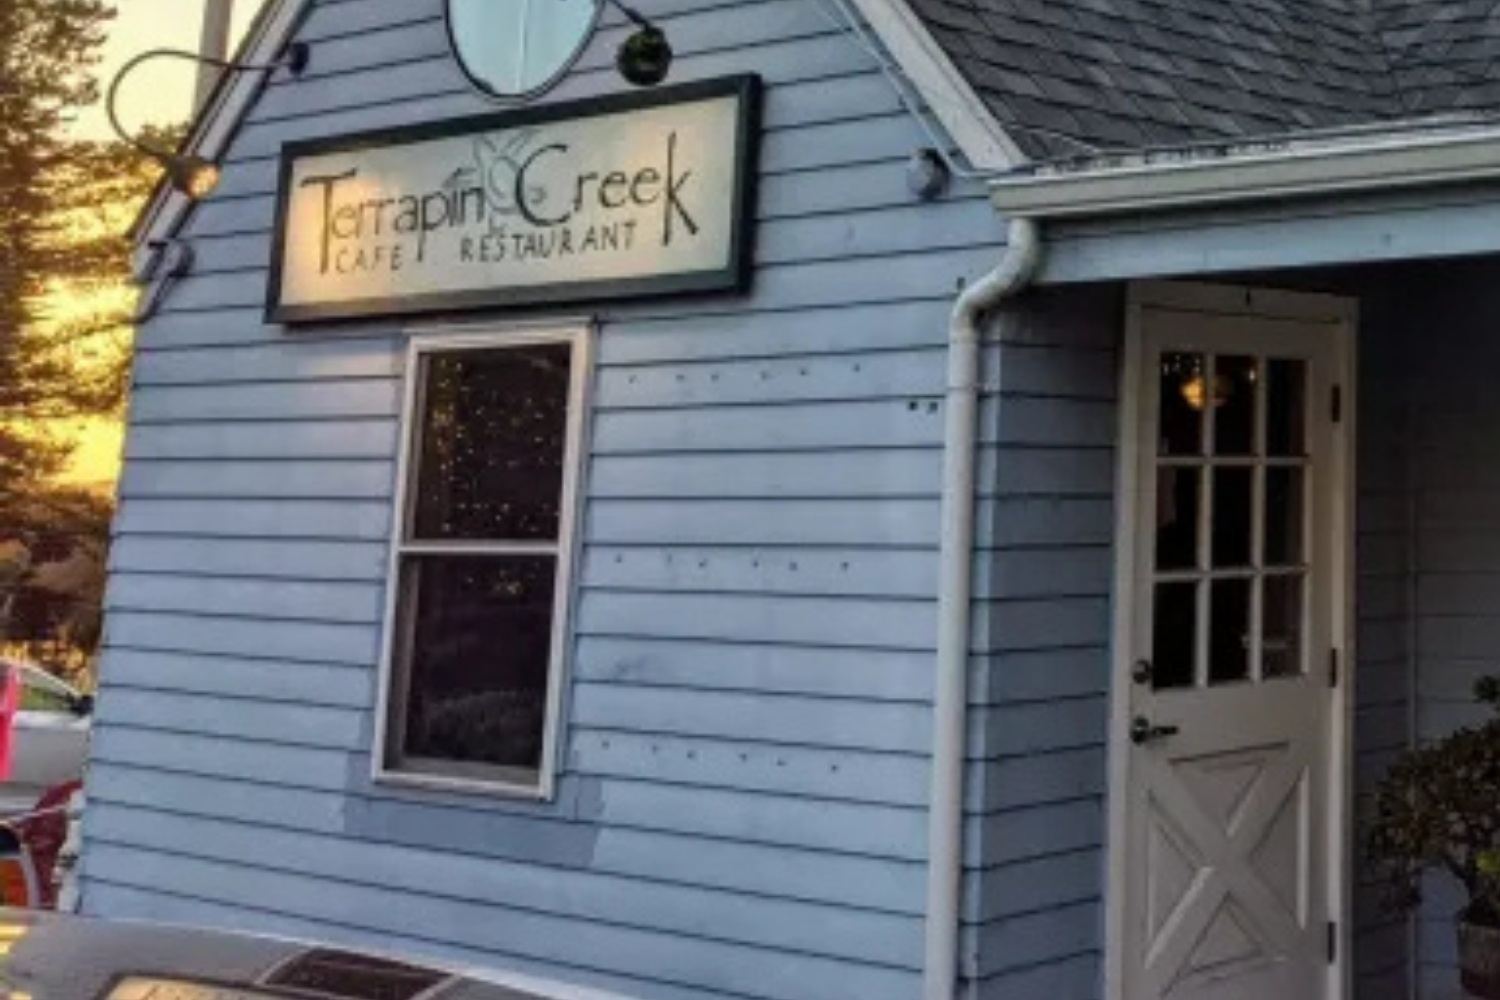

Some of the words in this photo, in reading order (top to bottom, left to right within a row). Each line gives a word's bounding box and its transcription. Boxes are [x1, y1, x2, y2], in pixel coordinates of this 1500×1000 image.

[301, 168, 485, 275] Terrapin
[515, 131, 699, 247] Creek
[335, 243, 403, 274] CAFE
[460, 220, 638, 263] RESTAURANT
